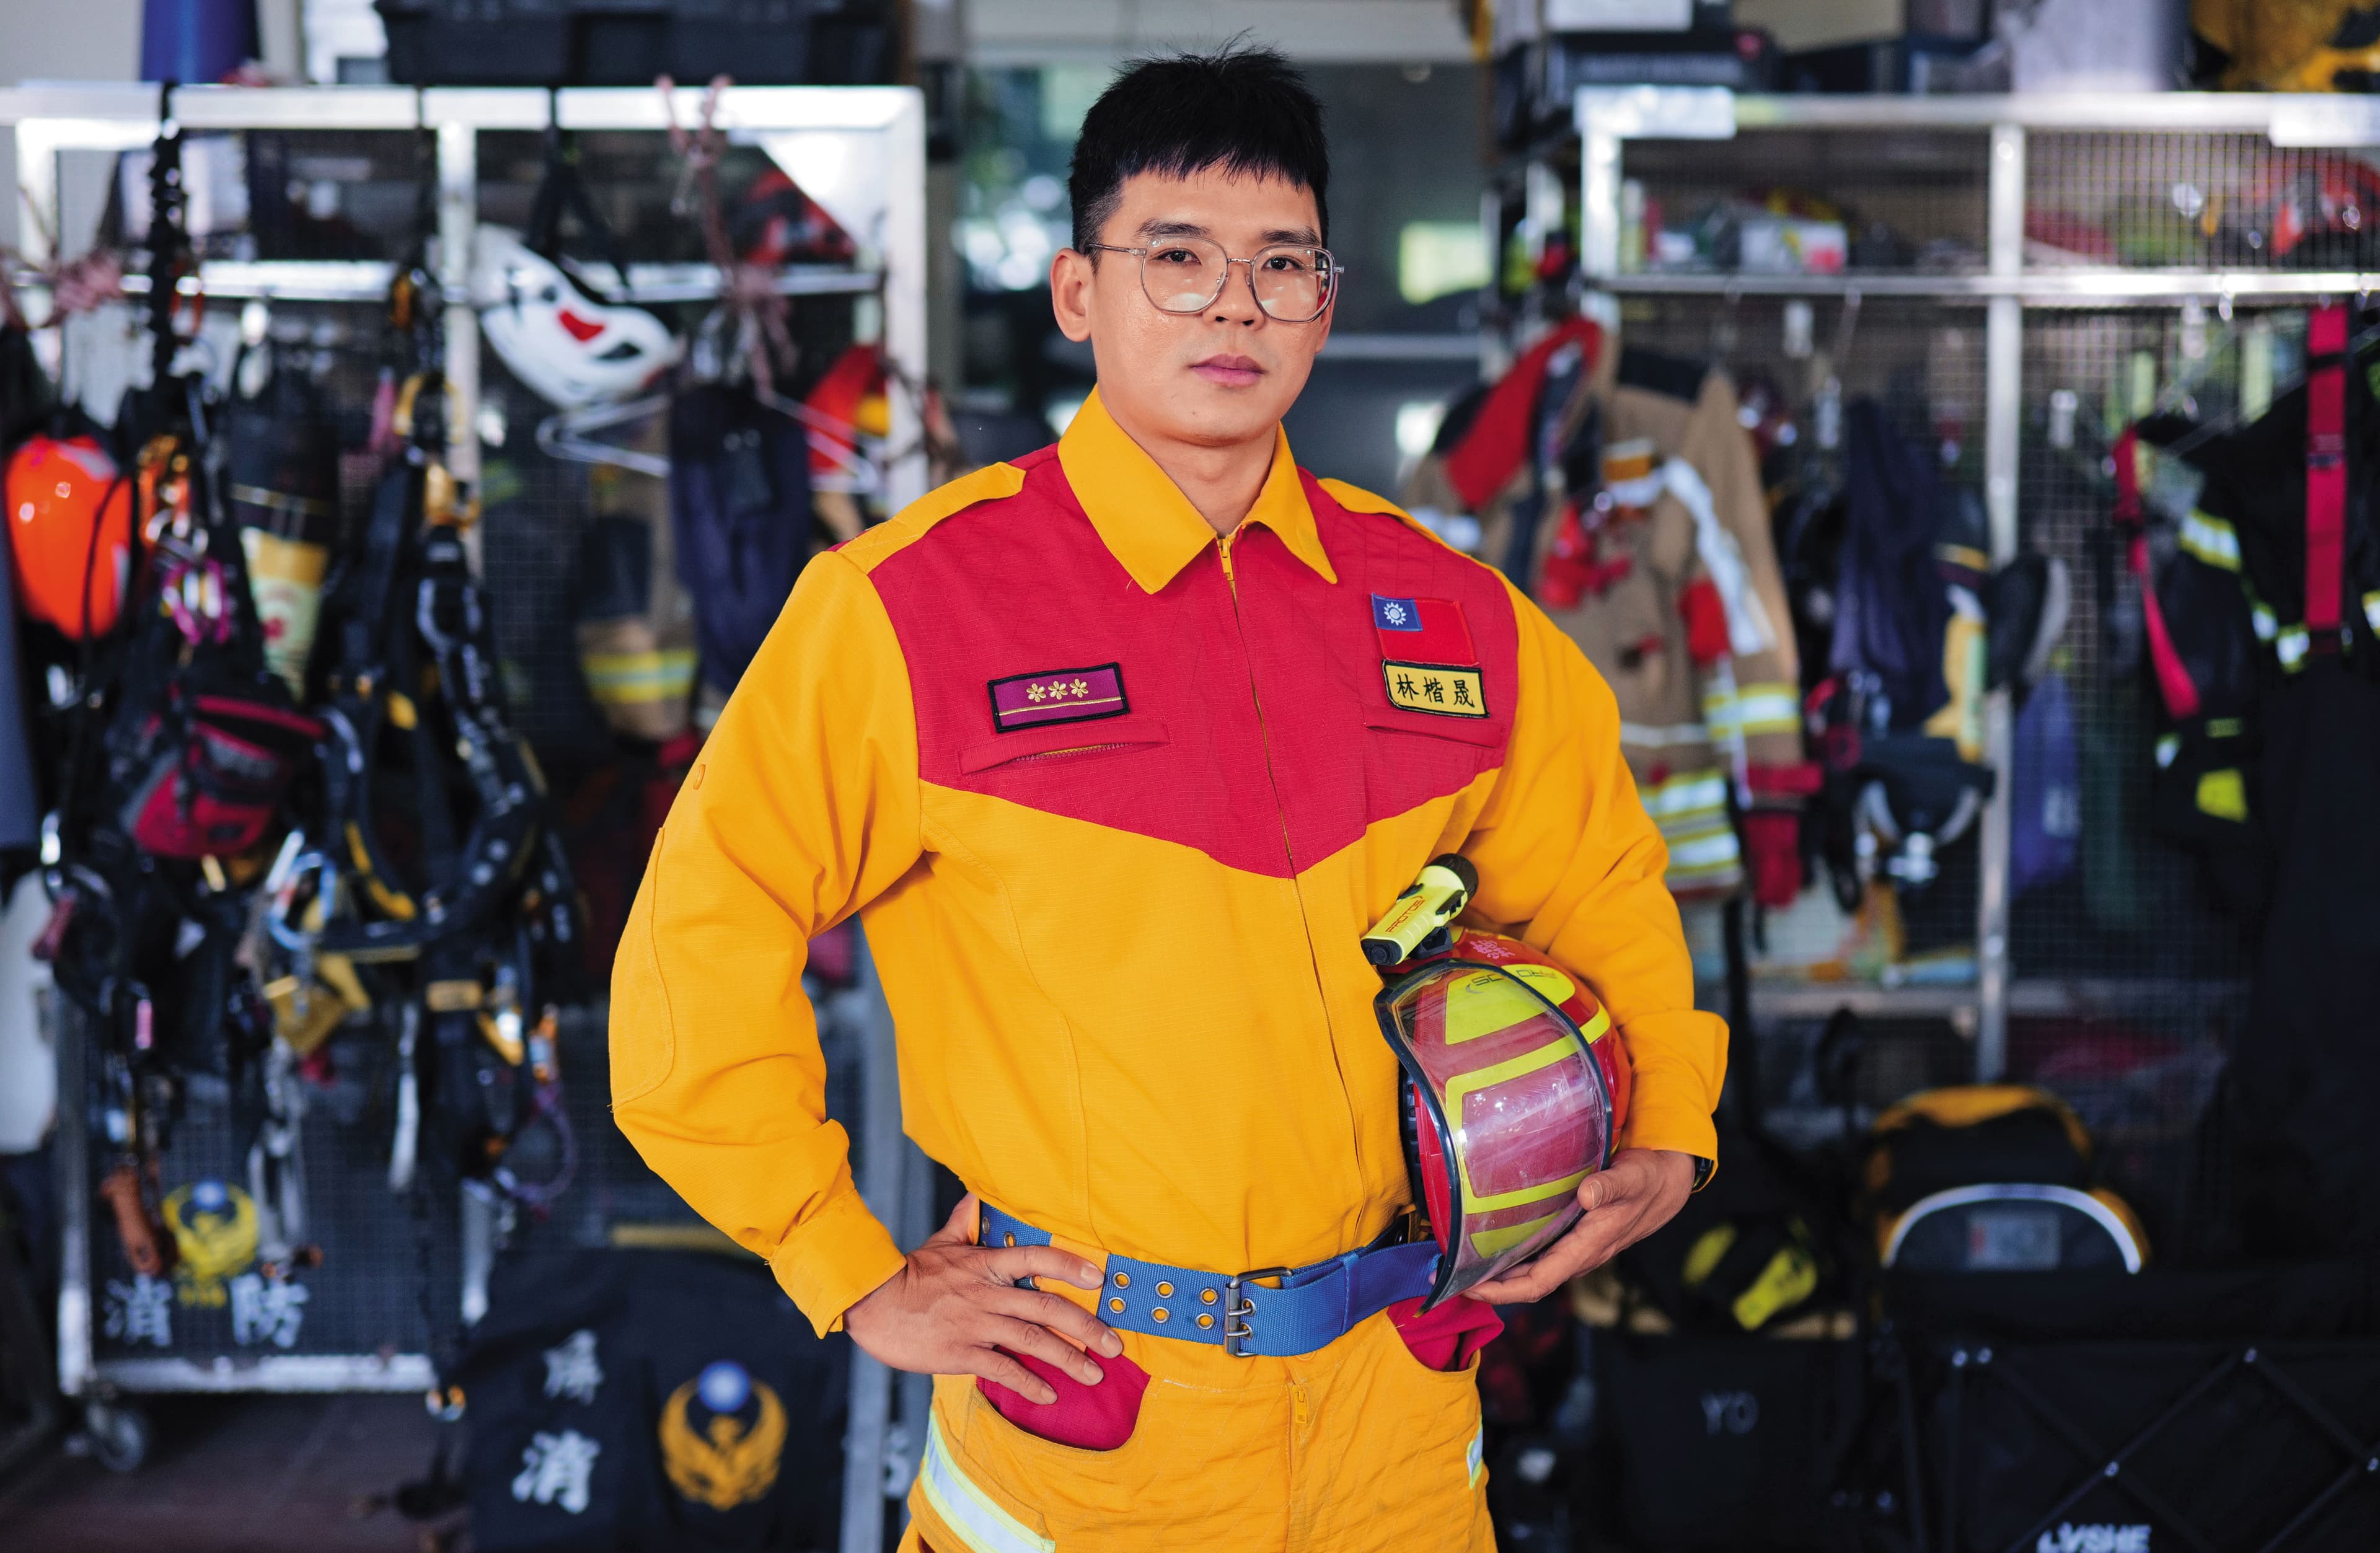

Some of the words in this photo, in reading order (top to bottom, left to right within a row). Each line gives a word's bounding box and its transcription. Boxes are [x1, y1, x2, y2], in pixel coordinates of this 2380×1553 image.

[1396, 673, 1475, 708] 林楷晟
[1385, 899, 1425, 933] PROTOS
